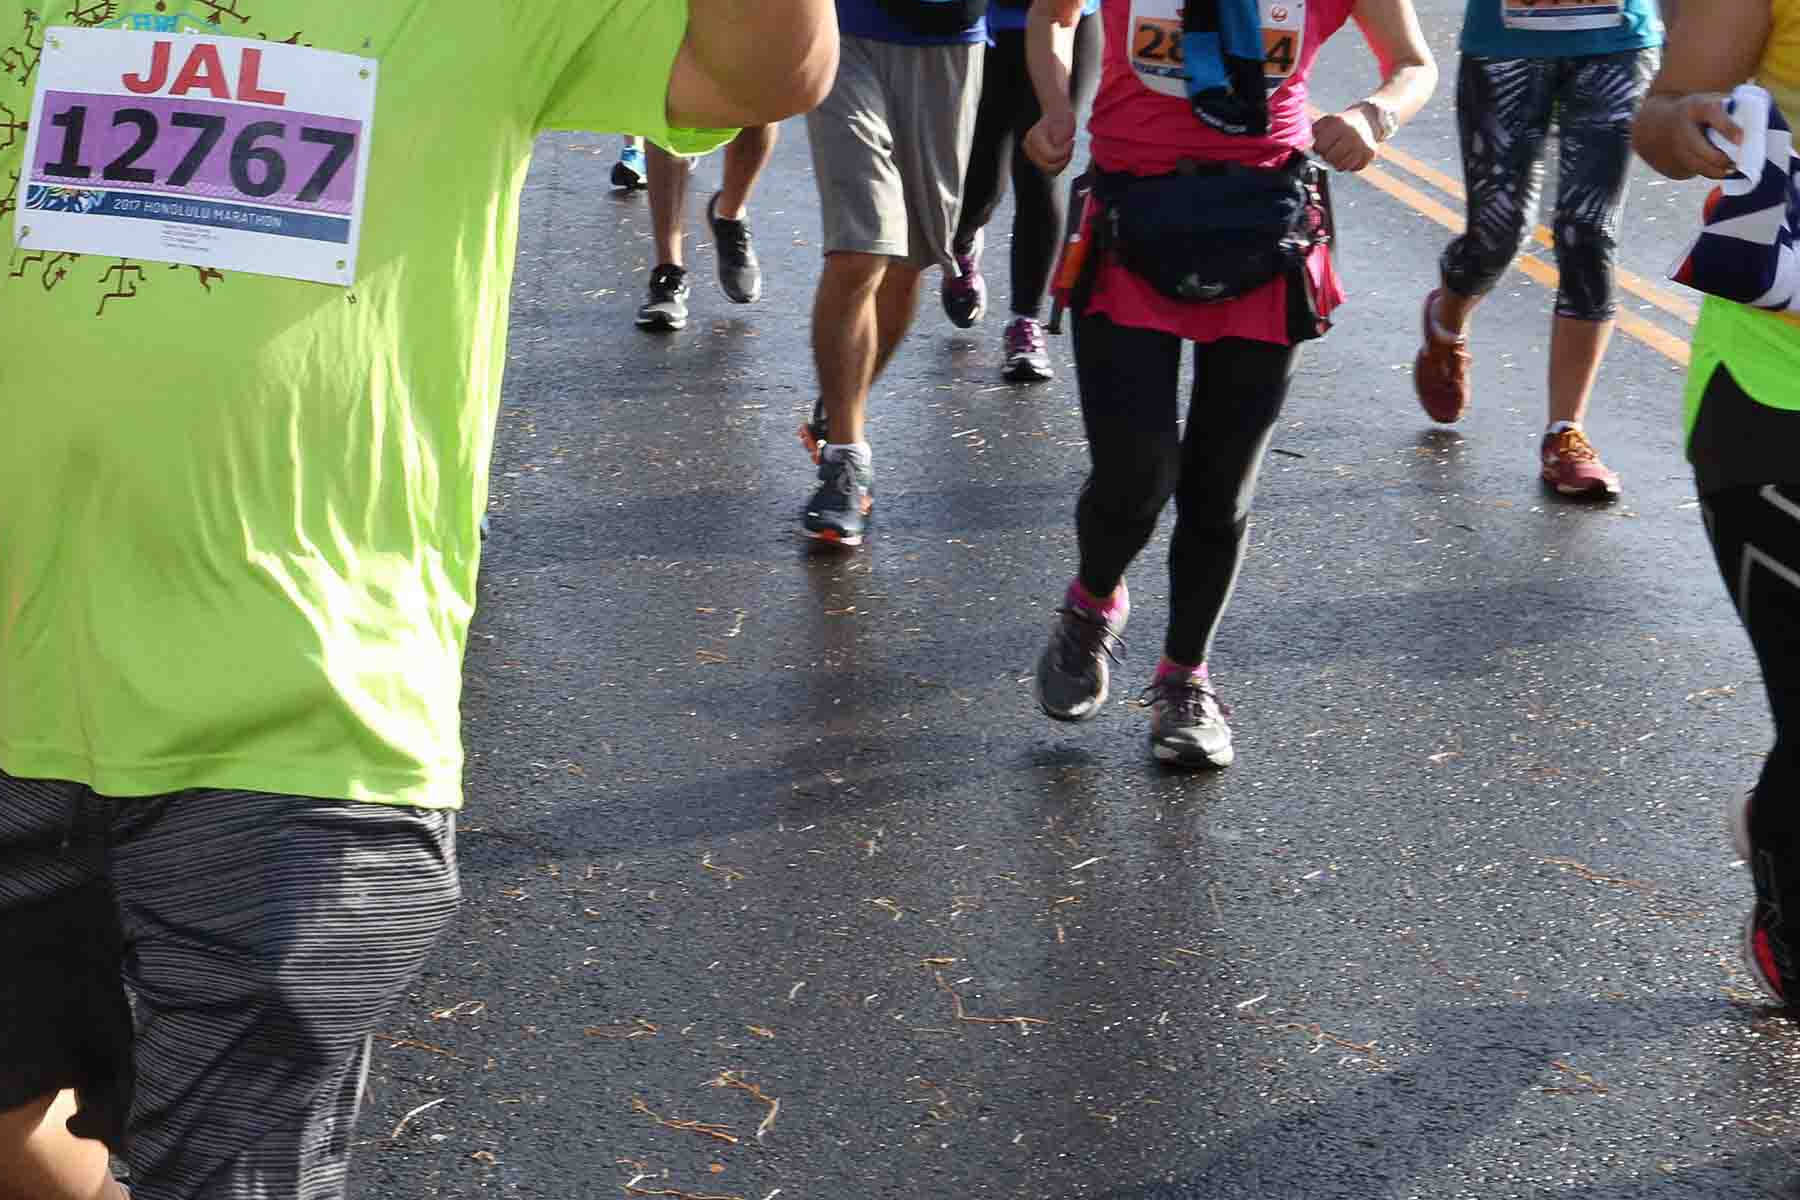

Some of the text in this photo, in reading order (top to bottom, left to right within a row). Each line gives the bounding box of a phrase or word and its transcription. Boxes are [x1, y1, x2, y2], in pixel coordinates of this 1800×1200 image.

[121, 41, 287, 107] JAL
[43, 105, 357, 203] 12767
[112, 198, 283, 229] 2017 HONOLULU MARATHON
